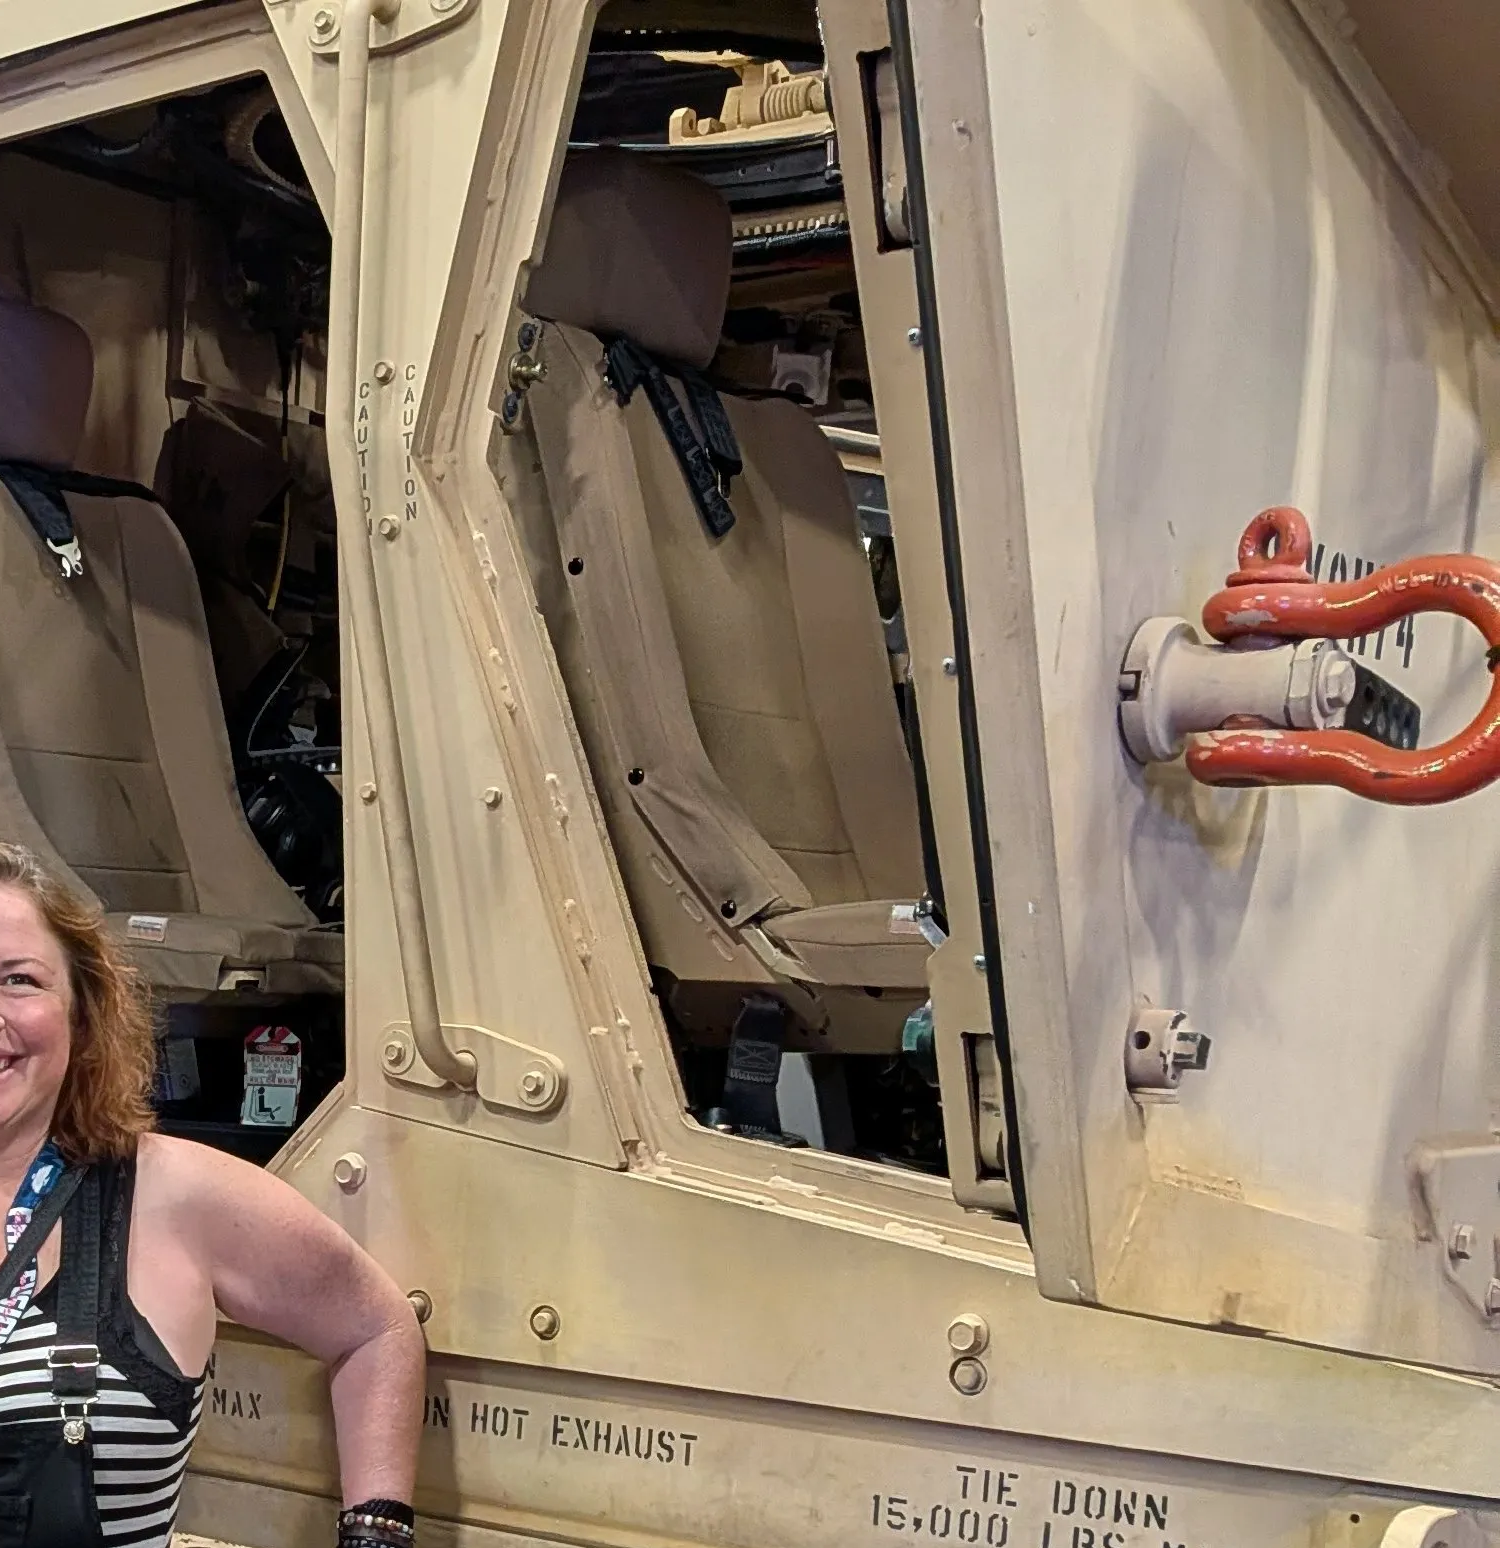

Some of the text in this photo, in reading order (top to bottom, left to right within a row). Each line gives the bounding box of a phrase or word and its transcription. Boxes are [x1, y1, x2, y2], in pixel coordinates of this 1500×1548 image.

[402, 364, 418, 521] CAUTION
[212, 1387, 262, 1420] MAX
[470, 1402, 529, 1440] HOT
[551, 1415, 699, 1467] EXHAUST
[872, 1494, 1009, 1548] 15,000
[956, 1465, 1169, 1531] TIE DOWN
